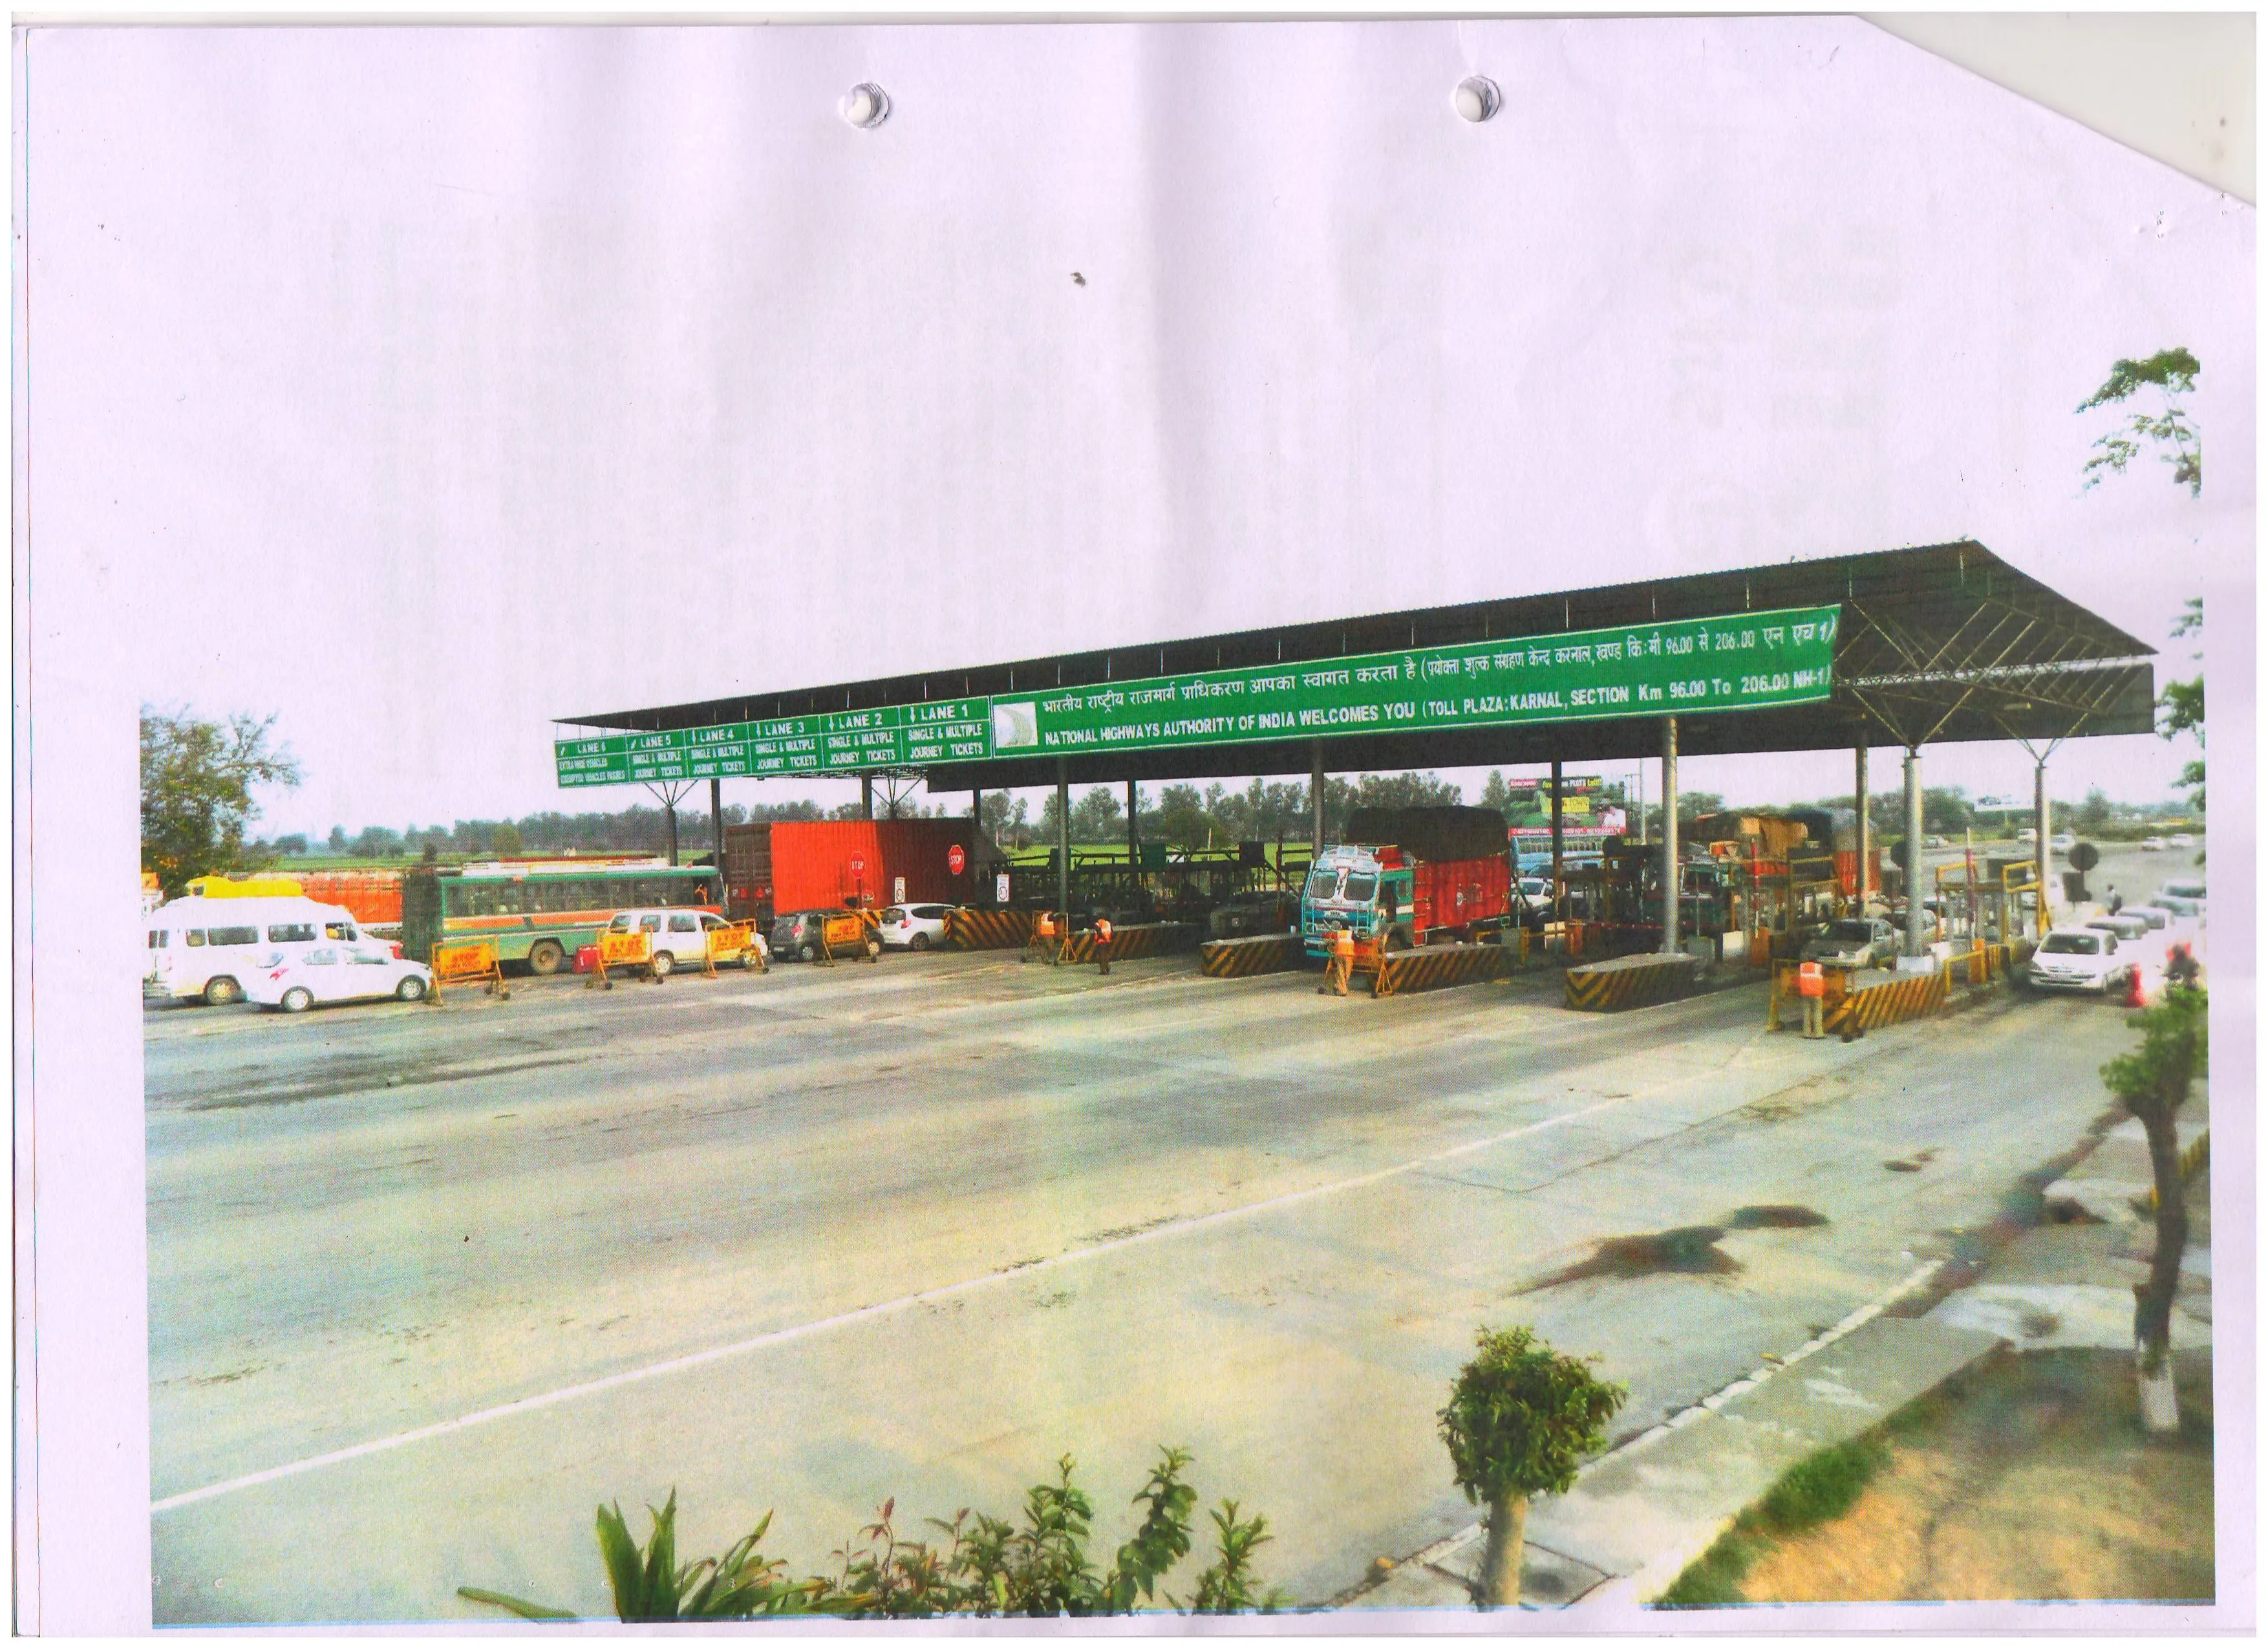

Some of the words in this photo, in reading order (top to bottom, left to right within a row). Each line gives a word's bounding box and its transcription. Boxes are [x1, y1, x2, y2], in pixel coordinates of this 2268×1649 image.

[1043, 693, 1083, 713] भारतीय
[1087, 689, 1124, 714] राष्ट्रीय
[1129, 681, 1176, 704] राजमार्ग
[1181, 680, 1244, 700] प्राधिकरण
[1250, 675, 1296, 693] आपका
[1301, 669, 1350, 688] स्वागत
[1356, 665, 1398, 683] करता
[1404, 656, 1416, 680] है
[1698, 627, 1709, 651] से
[1715, 630, 1755, 650] 206.00
[1762, 627, 1784, 649] एन
[921, 706, 956, 720] LANE
[961, 704, 968, 717] 1
[1045, 727, 1098, 745] NATIONAL
[1100, 722, 1160, 741] HIGHWAYS
[1164, 717, 1234, 737] AUTHORITY
[1238, 715, 1254, 731] OF
[1259, 711, 1295, 729] INDIA
[1299, 705, 1378, 726] WELCOMES
[1383, 702, 1415, 720] YOU
[1570, 686, 1629, 706] SECTION
[1638, 684, 1662, 701] Km
[1670, 680, 1706, 698] 96.00
[1712, 678, 1731, 695] To
[1741, 673, 1790, 693] 206.00
[765, 722, 793, 735] LANE
[798, 722, 805, 733] 3
[839, 715, 870, 729] LANE
[875, 713, 883, 725] 2
[700, 729, 725, 742] LANE
[727, 728, 734, 739] 4
[828, 735, 851, 748] SINGLE
[861, 731, 894, 746] MULTIPLE
[908, 727, 935, 742] SINGLE
[937, 727, 944, 739] &
[945, 724, 982, 738] MULTIPLE
[830, 752, 860, 764] JOURNEY
[866, 749, 896, 762] TICKETS
[910, 745, 943, 759] JOURNEY
[950, 742, 983, 755] TICKETS
[852, 861, 864, 870] STOP
